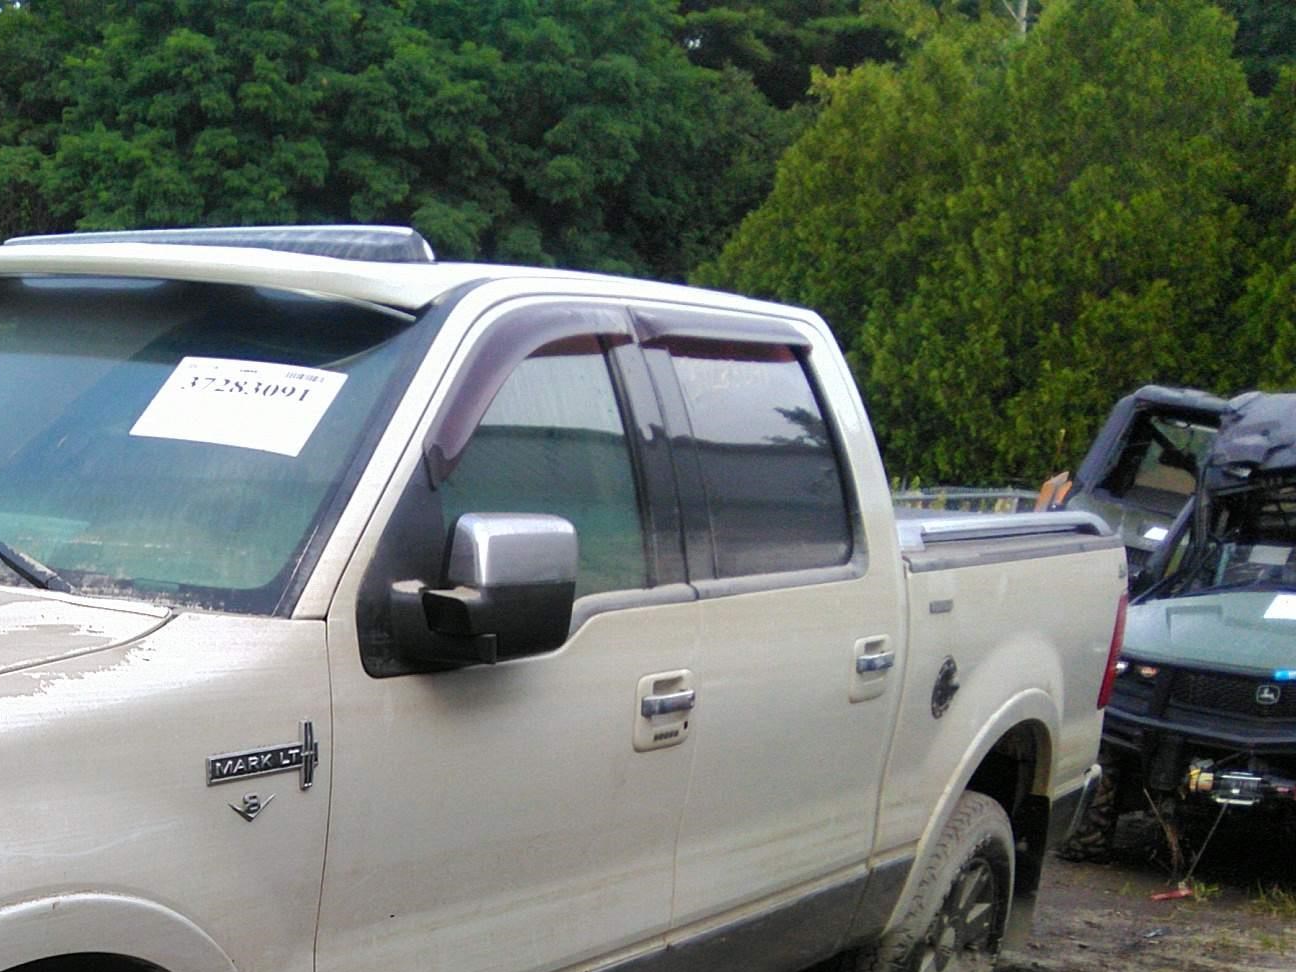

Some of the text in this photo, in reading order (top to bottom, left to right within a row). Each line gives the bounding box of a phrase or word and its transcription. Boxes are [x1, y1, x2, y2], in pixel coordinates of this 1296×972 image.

[181, 376, 310, 401] 37283091
[215, 749, 300, 776] MARK LT
